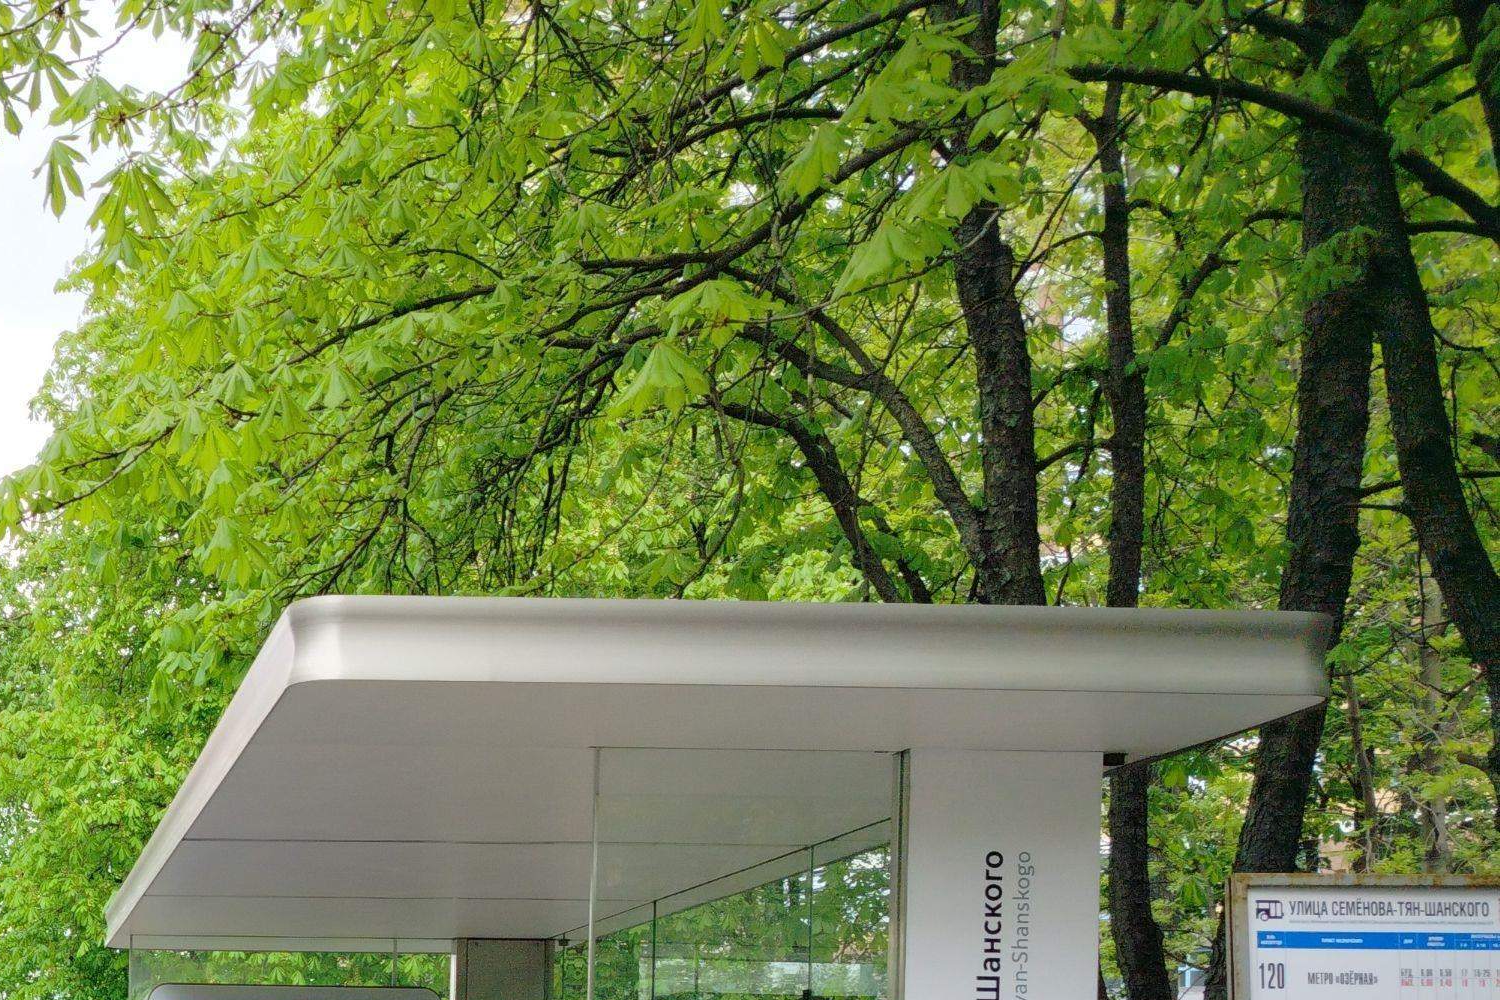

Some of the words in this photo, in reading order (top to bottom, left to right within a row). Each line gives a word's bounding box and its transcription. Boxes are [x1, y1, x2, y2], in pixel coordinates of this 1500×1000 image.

[1289, 901, 1328, 919] УЛИЦА
[1331, 898, 1489, 918] СЕМЁНОВА-ТЯН-ШАНСКОГО
[1259, 963, 1285, 990] 120
[1307, 972, 1333, 985] МЕТРО
